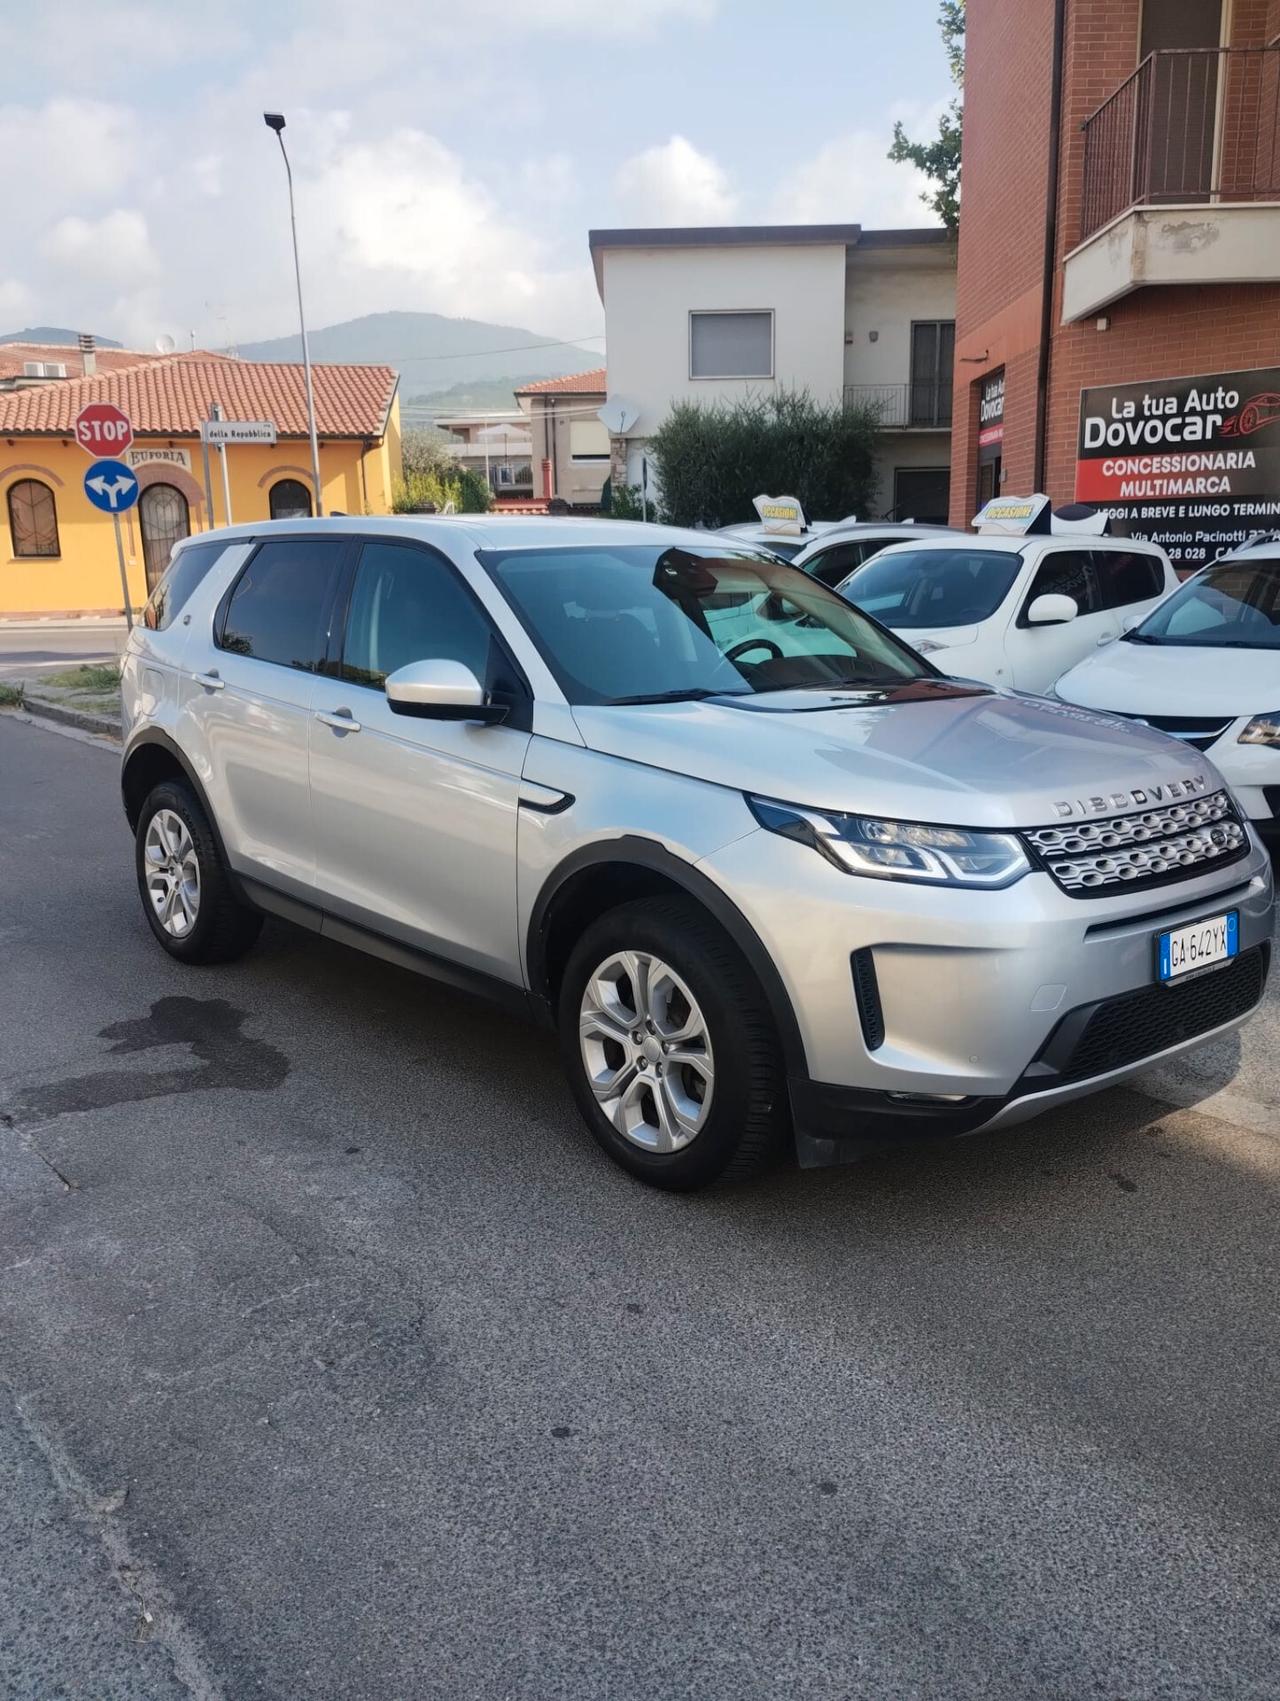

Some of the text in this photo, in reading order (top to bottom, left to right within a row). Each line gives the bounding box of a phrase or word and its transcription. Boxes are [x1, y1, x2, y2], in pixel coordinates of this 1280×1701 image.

[1111, 386, 1239, 419] La tua Auto
[79, 420, 128, 441] STOP
[209, 429, 271, 439] della Repubblica
[1084, 414, 1223, 449] Dovocar
[130, 450, 186, 466] EUFORIA
[1102, 451, 1256, 476] CONCESSIONARIA
[1120, 476, 1231, 497] MULTIMARCA
[1131, 507, 1138, 519] A
[1141, 506, 1175, 518] BREVE
[1179, 506, 1185, 518] E
[1189, 504, 1230, 517] LUNGO
[1233, 502, 1280, 515] TERMIN
[1131, 531, 1148, 542] Via
[1150, 530, 1191, 543] Antonio
[1195, 529, 1246, 543] Pacinotti
[1185, 547, 1206, 559] 028
[1051, 775, 1205, 818] DISCOVERY
